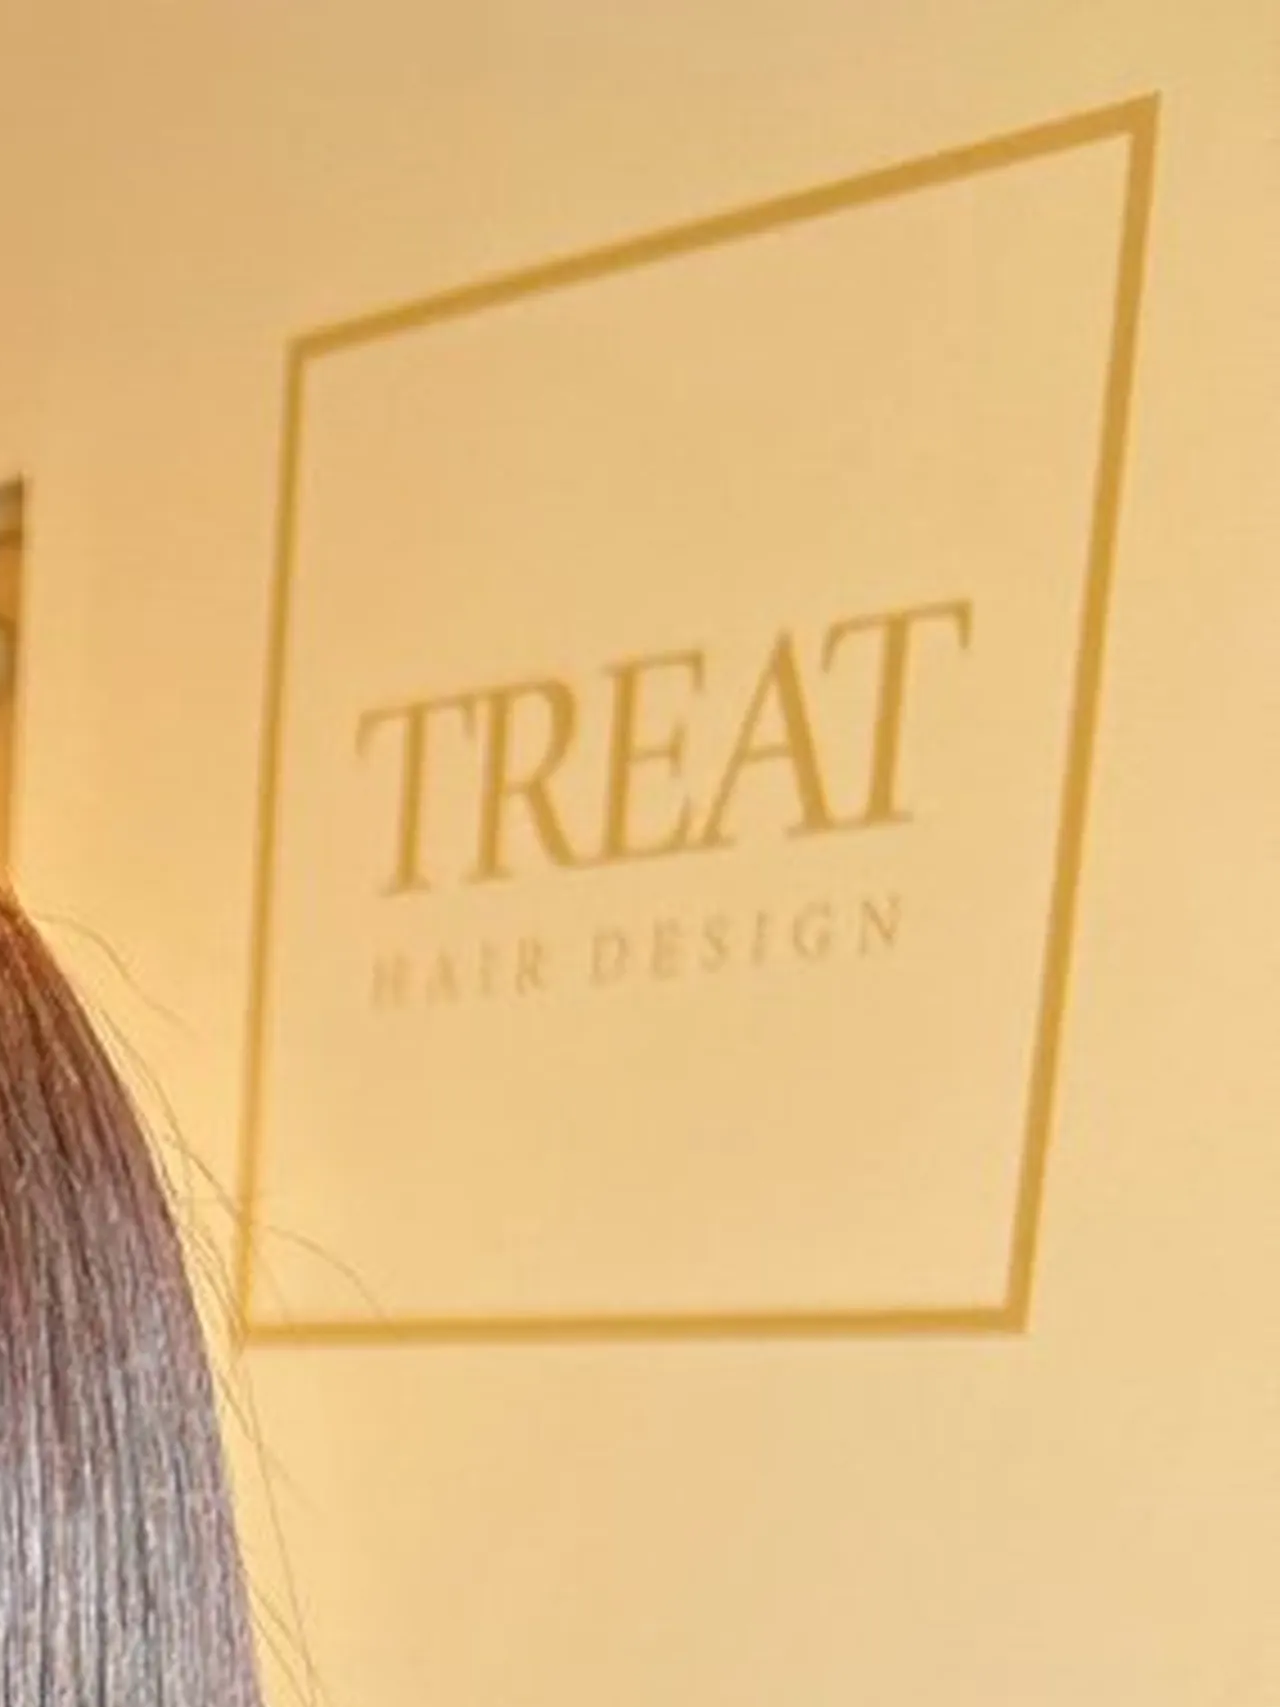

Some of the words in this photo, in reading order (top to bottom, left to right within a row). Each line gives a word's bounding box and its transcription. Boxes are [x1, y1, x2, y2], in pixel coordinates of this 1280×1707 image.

[354, 600, 974, 895] TREAT
[370, 934, 547, 1010] HAIR
[590, 893, 902, 988] DESIGN
